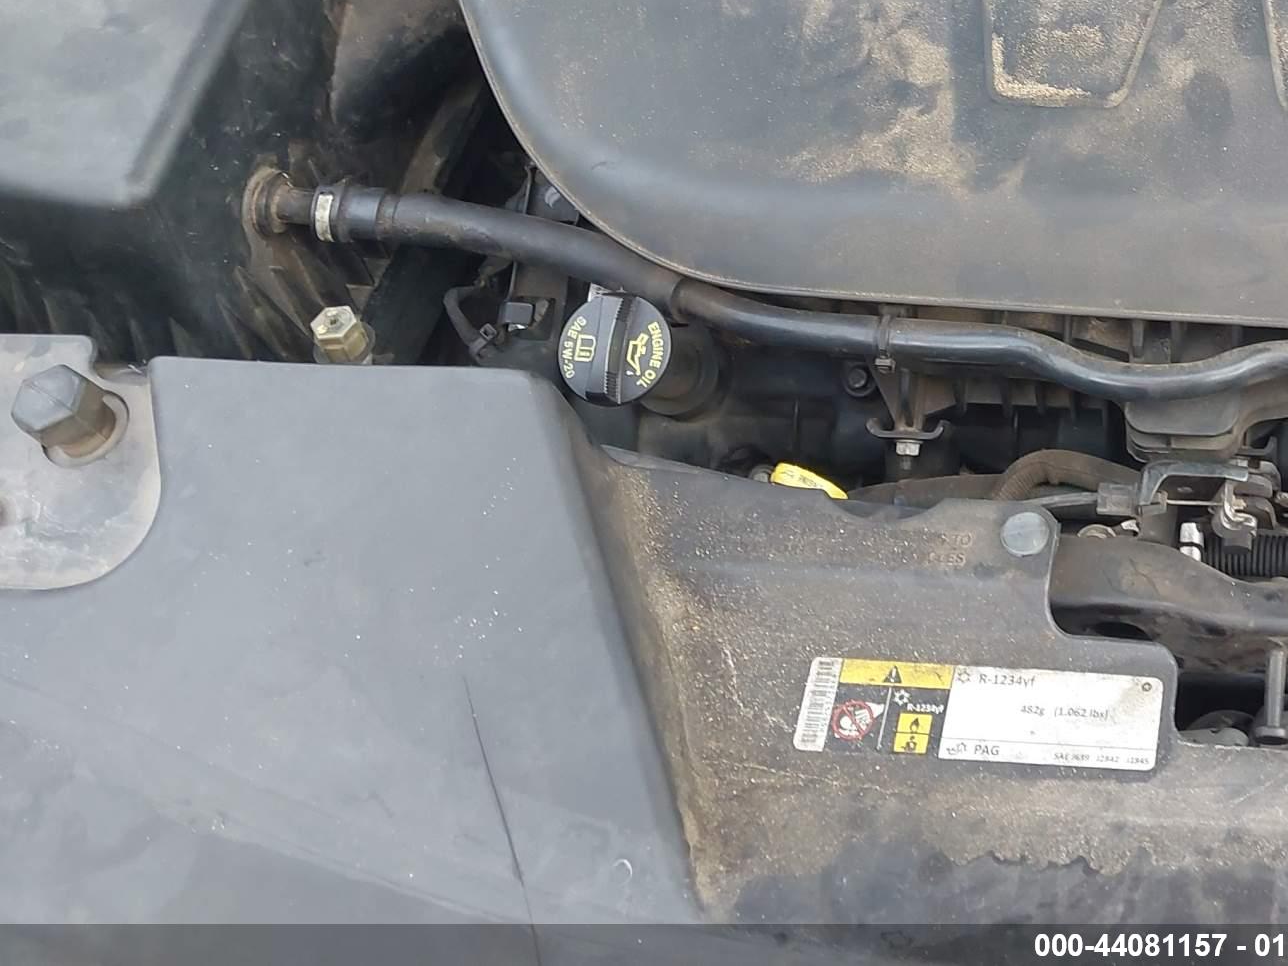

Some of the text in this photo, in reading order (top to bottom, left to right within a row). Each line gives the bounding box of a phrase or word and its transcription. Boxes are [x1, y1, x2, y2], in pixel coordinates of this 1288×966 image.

[562, 316, 587, 379] SAE 5W-20
[636, 321, 664, 388] ENGINE OIL
[979, 673, 1036, 688] R-1234yf
[973, 744, 1001, 757] PAG
